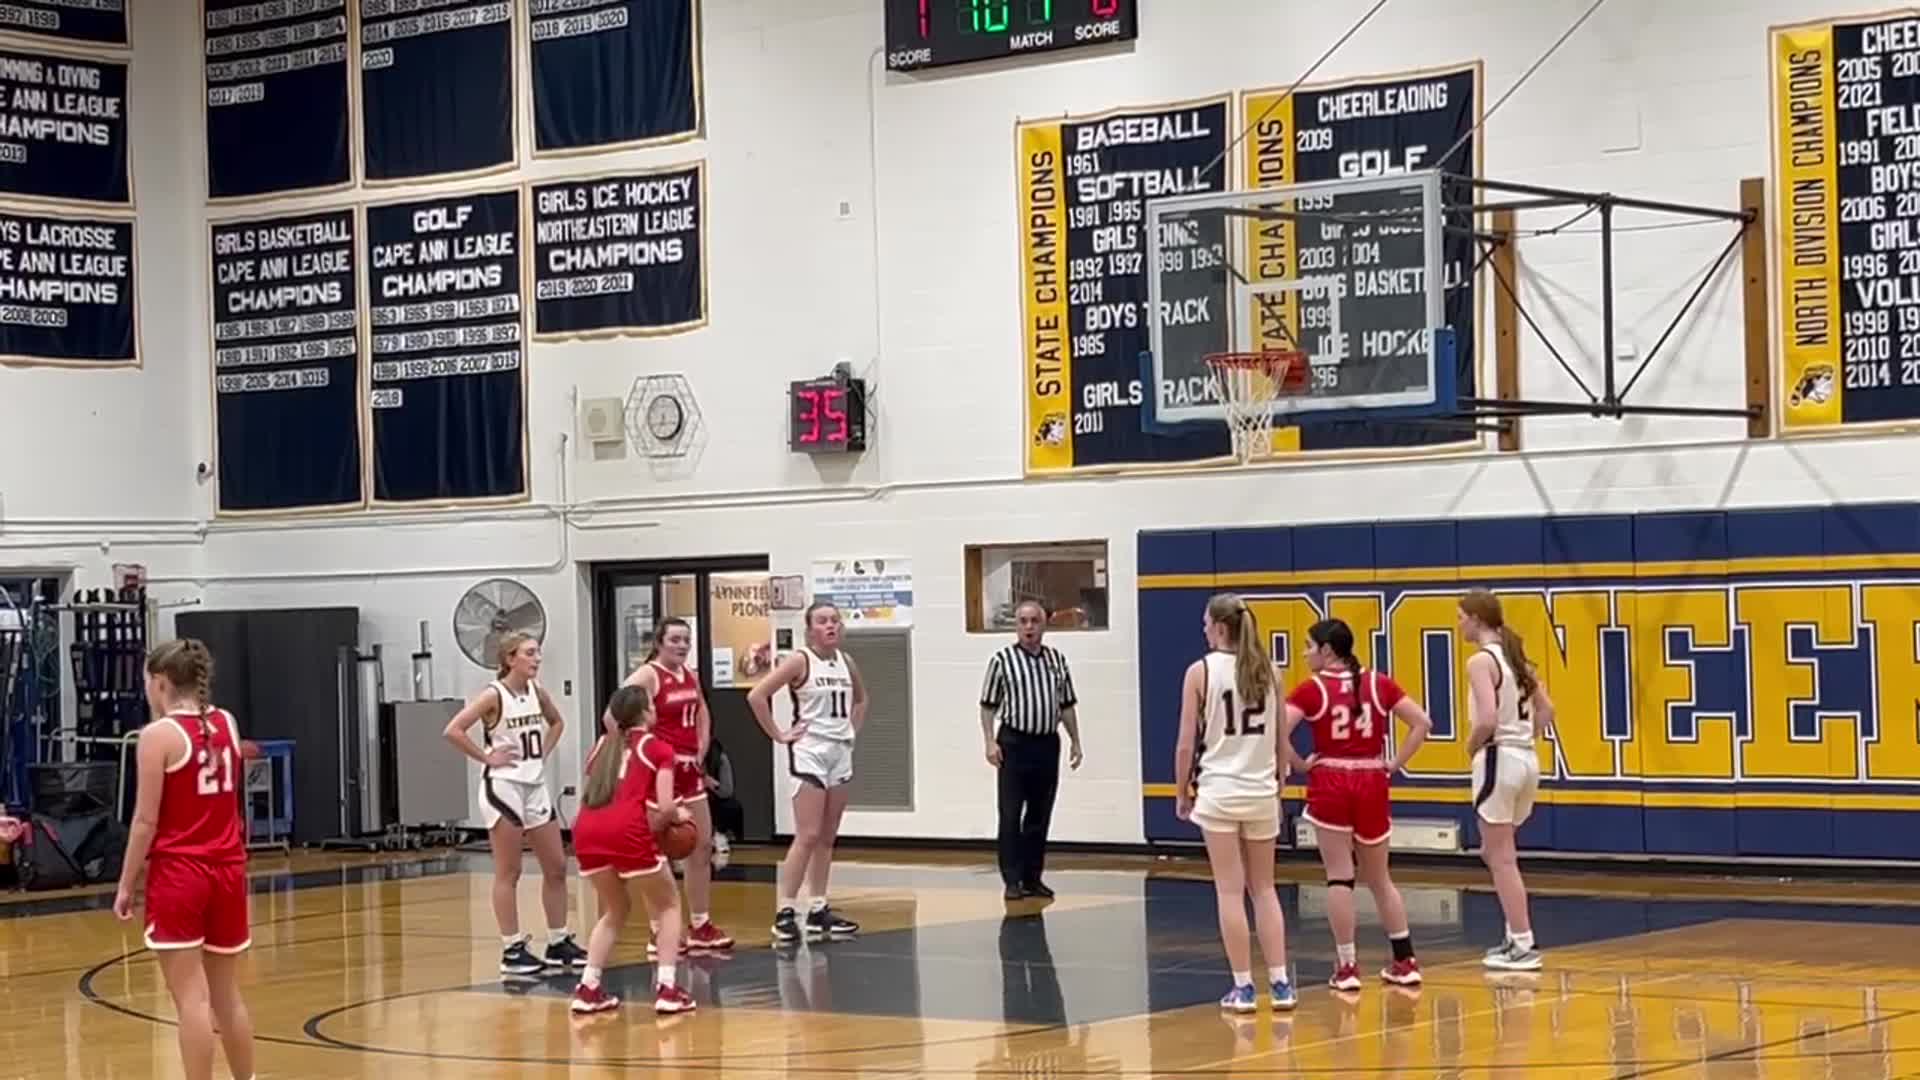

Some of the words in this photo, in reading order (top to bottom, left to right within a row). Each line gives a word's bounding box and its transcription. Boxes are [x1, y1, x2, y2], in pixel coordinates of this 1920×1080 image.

[1010, 31, 1053, 50] MATCH
[1074, 20, 1120, 41] SCORE
[1862, 20, 1920, 55] CHEE
[889, 48, 931, 67] SCORE
[1838, 56, 1882, 82] 2005
[58, 65, 100, 91] DIVING
[13, 88, 47, 111] ANN
[54, 93, 120, 118] LEAGUE
[1317, 82, 1449, 123] CHEERLEADING
[1789, 49, 1824, 168] CHAMPIONS
[1838, 82, 1882, 109] 2021
[1077, 112, 1210, 151] BASEBALL
[1296, 128, 1333, 151] 2009
[0, 145, 25, 161] 013
[1067, 152, 1100, 176] 1961
[1338, 145, 1428, 179] GOLF
[1839, 139, 1880, 166] 1991
[538, 188, 587, 214] GIRLS
[592, 183, 619, 208] ICE
[624, 176, 692, 206] HOCKEY
[1077, 166, 1211, 203] SOFTBALL
[413, 205, 472, 233] GOLF
[1793, 178, 1827, 267] DIVISION
[1840, 195, 1886, 222] 2006
[27, 223, 116, 250] LACROSSE
[215, 230, 256, 255] GIRLS
[259, 220, 351, 251] BASKETBALL
[537, 212, 639, 244] NORTHEASTERN
[644, 206, 696, 235] LEAGUE
[1031, 150, 1057, 304] CHAMPIONS
[1092, 224, 1138, 253] GIRLS
[0, 248, 14, 270] E
[19, 251, 55, 274] ANN
[61, 253, 127, 277] LEAGUE
[373, 242, 414, 268] CAPE
[419, 239, 449, 264] ANN
[454, 232, 514, 259] LEAGUE
[549, 238, 683, 272] CHAMPIONS
[1299, 246, 1336, 270] 2003
[218, 260, 256, 284] CAPE
[260, 256, 288, 280] ANN
[292, 250, 351, 276] LEAGUE
[382, 264, 502, 297] CHAMPIONS
[1069, 256, 1104, 281] 1992
[1108, 252, 1143, 276] 1997
[1842, 253, 1888, 280] 1996
[228, 281, 342, 312] CHAMPIONS
[1070, 281, 1103, 305] 2014
[1085, 302, 1137, 331] BOYS
[1794, 276, 1828, 347] NORTH
[1844, 310, 1889, 336] 1998
[1035, 315, 1062, 397] STATE
[1073, 334, 1106, 357] 1985
[1362, 330, 1432, 358] HOCKE
[1846, 335, 1890, 362] 2010
[1846, 361, 1891, 388] 2014
[1083, 380, 1143, 409] GIRLS
[1162, 376, 1219, 405] RACK
[798, 390, 847, 441] 35
[1074, 411, 1104, 434] 2011
[682, 703, 697, 728] 11
[830, 690, 848, 718] 11
[1222, 688, 1266, 736] 12
[1331, 701, 1373, 740] 24
[520, 730, 543, 761] 10
[197, 745, 233, 795] 21
